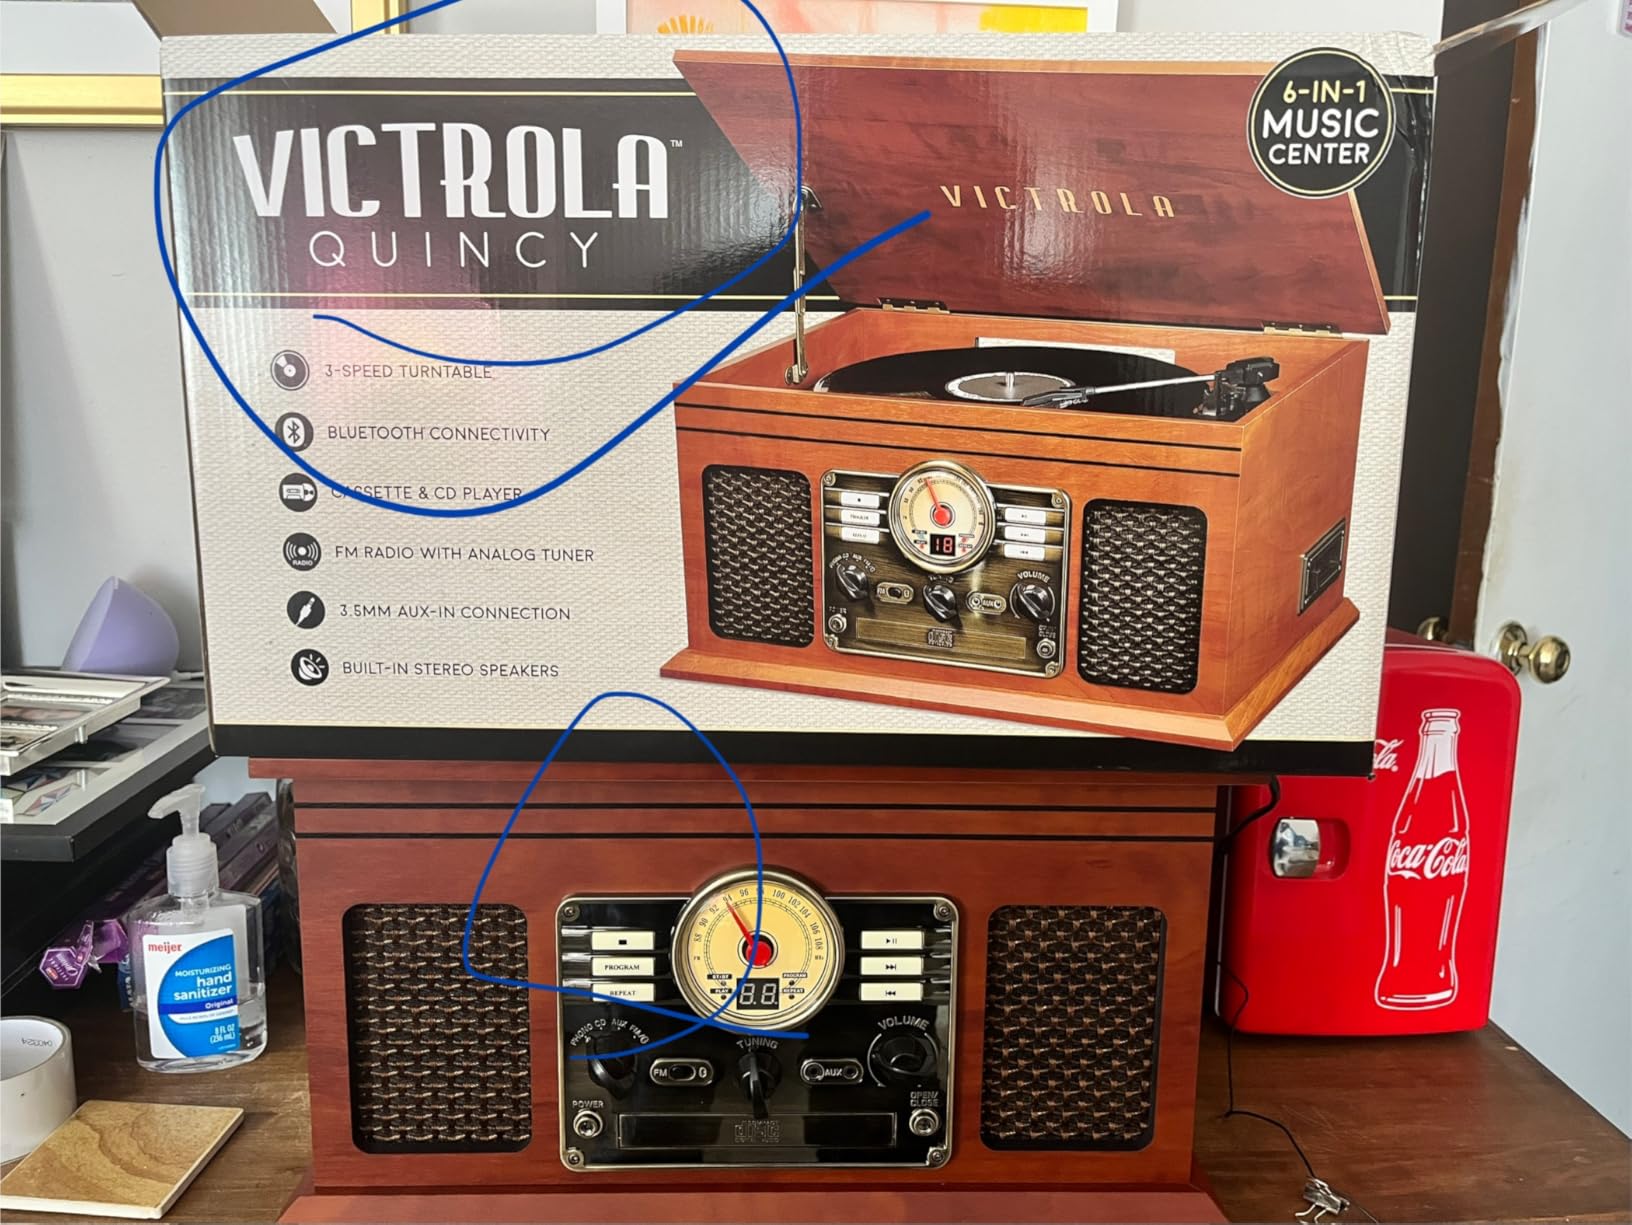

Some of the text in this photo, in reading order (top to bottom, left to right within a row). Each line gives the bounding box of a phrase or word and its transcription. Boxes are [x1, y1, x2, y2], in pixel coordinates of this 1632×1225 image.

[1282, 79, 1366, 104] 6-IN-1
[1262, 108, 1380, 140] MUSIC
[1268, 143, 1370, 165] CENTER
[233, 122, 668, 219] VICTROLA
[940, 185, 1175, 218] VICTROLA
[309, 231, 599, 268] QUINCY
[325, 364, 492, 378] 3-SPEED TURNTABLE
[327, 425, 551, 442] BLUETOOTH CONNECTIVITY
[418, 487, 429, 500] &
[434, 486, 457, 500] CD
[335, 545, 595, 562] FM RADIO WITH ANALOG TUNER
[1017, 570, 1050, 583] VOLUME
[339, 604, 571, 621] 3.5MM AUX-IN CONNECTION
[342, 661, 559, 677] BUILT-IN STEREO SPEAKERS
[739, 889, 749, 897] 96
[772, 889, 786, 899] 100
[799, 906, 812, 918] 104
[810, 922, 820, 935] 106
[148, 941, 182, 954] meijer
[175, 963, 232, 977] MOISTURIZING
[196, 972, 233, 987] hand
[173, 984, 233, 1001] sanitizer
[204, 998, 234, 1010] Original
[877, 1015, 930, 1031] VOLUME
[570, 1022, 593, 1047] PHONO
[594, 1018, 607, 1028] CD
[611, 1018, 629, 1028] AUX
[736, 1037, 779, 1049] TUNING
[653, 1068, 668, 1077] FM
[824, 1068, 843, 1077] AUX
[909, 1091, 939, 1099] OPEN/
[909, 1099, 939, 1107] CLOSE
[572, 1100, 604, 1109] POWER
